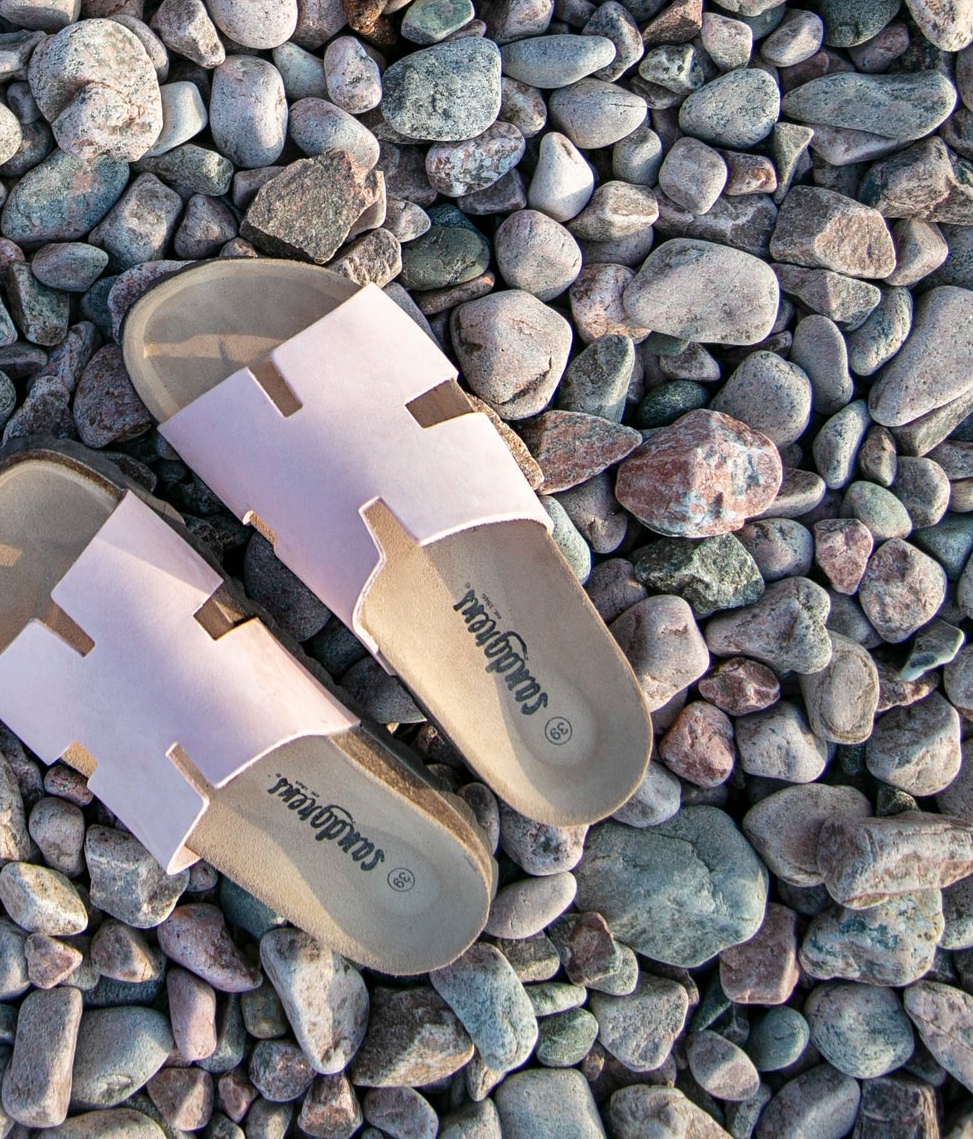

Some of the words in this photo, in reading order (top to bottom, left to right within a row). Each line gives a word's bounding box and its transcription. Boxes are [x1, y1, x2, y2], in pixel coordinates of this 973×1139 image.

[453, 589, 548, 715] sandgrens
[550, 722, 568, 740] 39
[267, 778, 385, 871] sandgrens
[393, 872, 411, 888] 39
